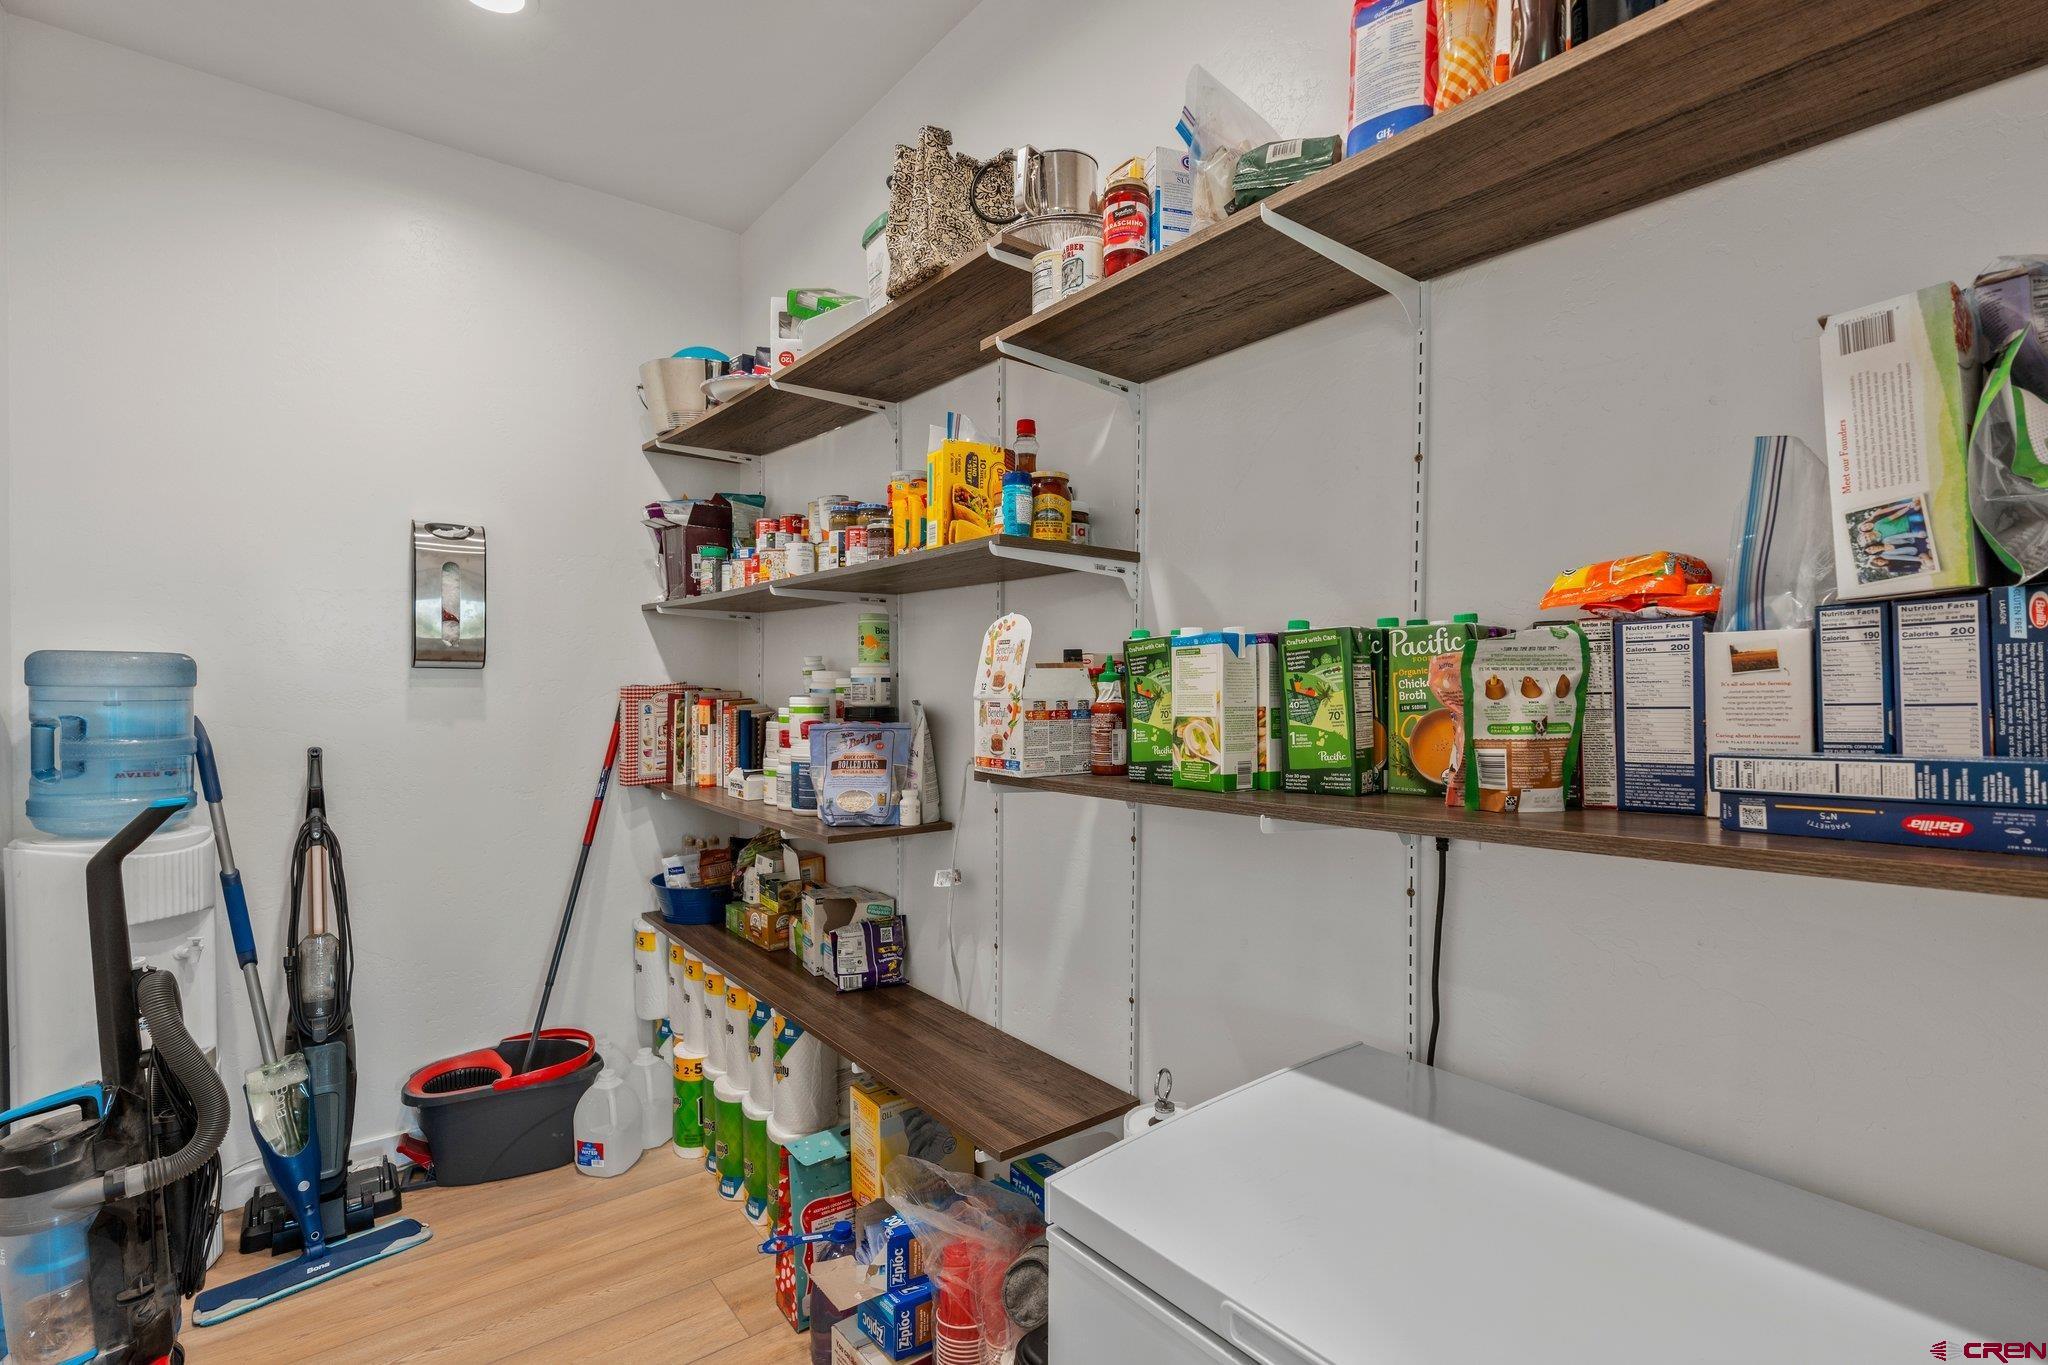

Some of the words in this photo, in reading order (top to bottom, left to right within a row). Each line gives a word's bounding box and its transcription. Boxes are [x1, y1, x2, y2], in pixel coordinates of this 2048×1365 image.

[1837, 419, 1849, 456] Founders
[1842, 458, 1850, 472] our
[1841, 473, 1851, 494] Meet
[1901, 604, 1944, 613] Nutrition
[1947, 601, 1975, 609] Facts
[2012, 588, 2021, 615] GLUTEN
[1821, 610, 1855, 618] Nutrition
[1999, 599, 2007, 625] LASAGNE
[2035, 600, 2047, 626] Barilla
[2014, 617, 2023, 634] FREE
[1863, 631, 1880, 639] 190
[1901, 630, 1940, 638] Calories
[1950, 626, 1976, 636] 200
[1286, 637, 1308, 646] Crafted
[1308, 635, 1322, 643] with
[1389, 626, 1465, 657] Pacific
[1128, 645, 1144, 653] Crafted
[1143, 643, 1154, 651] with
[1670, 643, 1690, 651] 200
[1398, 668, 1429, 677] Organic
[1399, 678, 1430, 689] Chick
[1399, 690, 1427, 700] Broth
[2038, 680, 2046, 702] prepared
[1289, 701, 1300, 709] 40
[848, 736, 866, 750] Red
[1009, 747, 1017, 756] 12
[1317, 750, 1347, 762] Pacific
[837, 760, 862, 770] ROLLED
[861, 760, 880, 770] OATS
[1806, 819, 1851, 831] SPAGHETTI
[1911, 818, 1965, 834] Barilla
[275, 1085, 288, 1120] Bona
[307, 1263, 331, 1274] Bona
[892, 1248, 904, 1285] Ziploc
[862, 1312, 885, 1344] Ziploc
[899, 1310, 911, 1350] Ziploc
